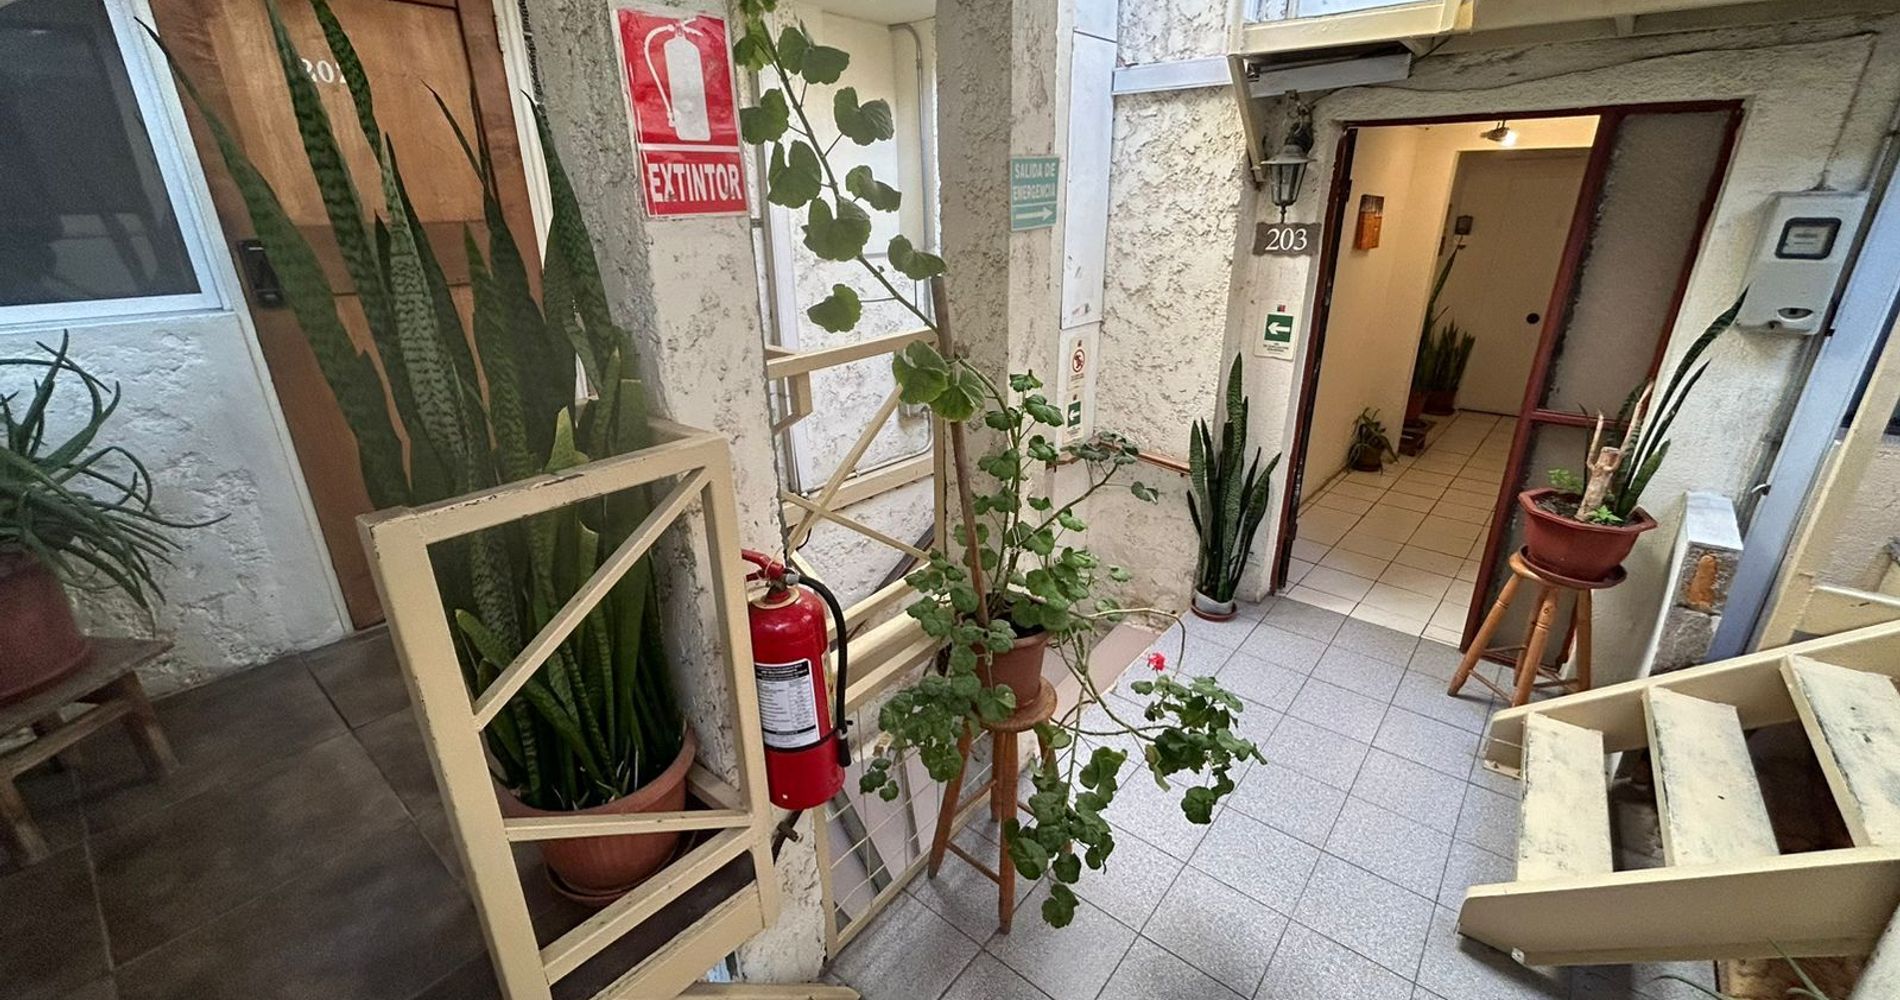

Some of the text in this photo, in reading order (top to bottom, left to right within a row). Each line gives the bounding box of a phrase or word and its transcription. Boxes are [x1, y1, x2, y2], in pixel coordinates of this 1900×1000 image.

[1015, 162, 1056, 178] SALIDA DE
[649, 163, 742, 202] EXTINTOR
[1265, 228, 1308, 251] 203
